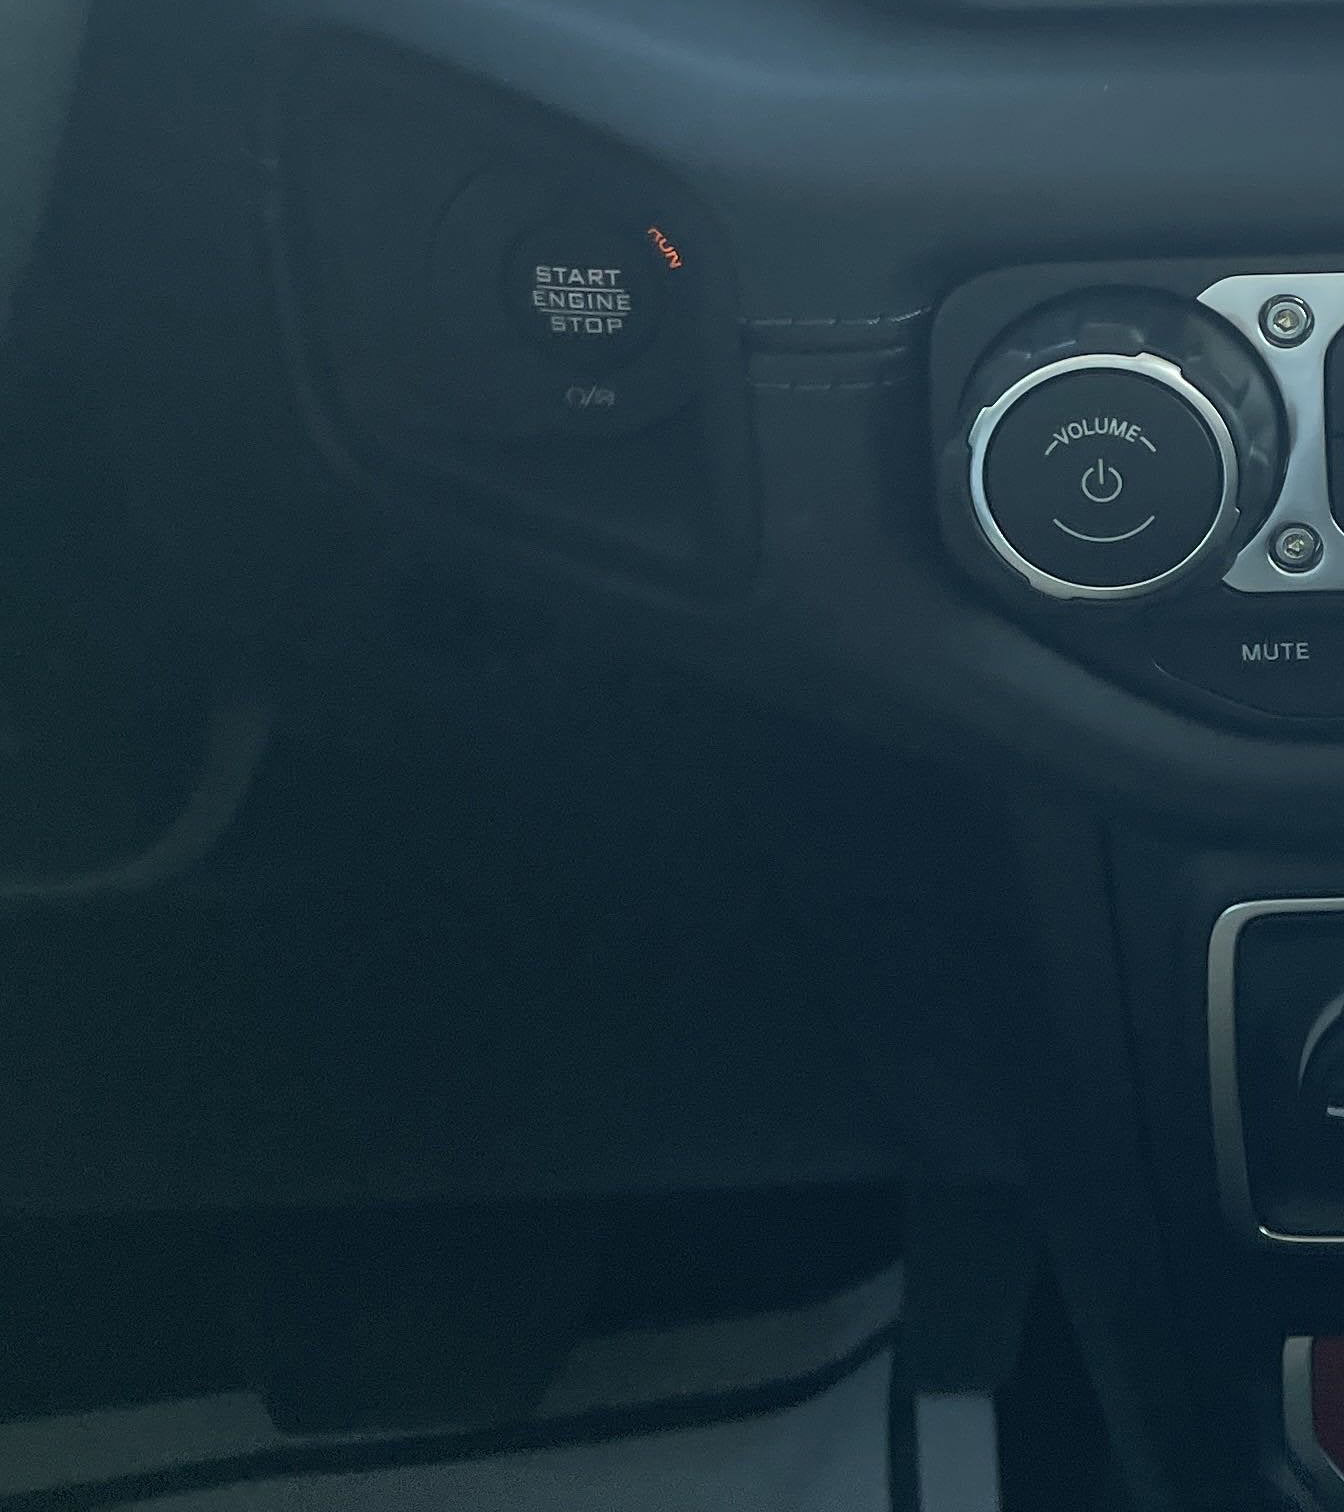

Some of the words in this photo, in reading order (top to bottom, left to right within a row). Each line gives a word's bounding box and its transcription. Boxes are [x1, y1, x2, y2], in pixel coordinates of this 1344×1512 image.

[536, 266, 621, 286] START
[533, 290, 631, 311] ENGINE
[551, 316, 623, 334] STOP
[1054, 417, 1142, 445] VOLUME
[1241, 641, 1310, 662] MUTE
